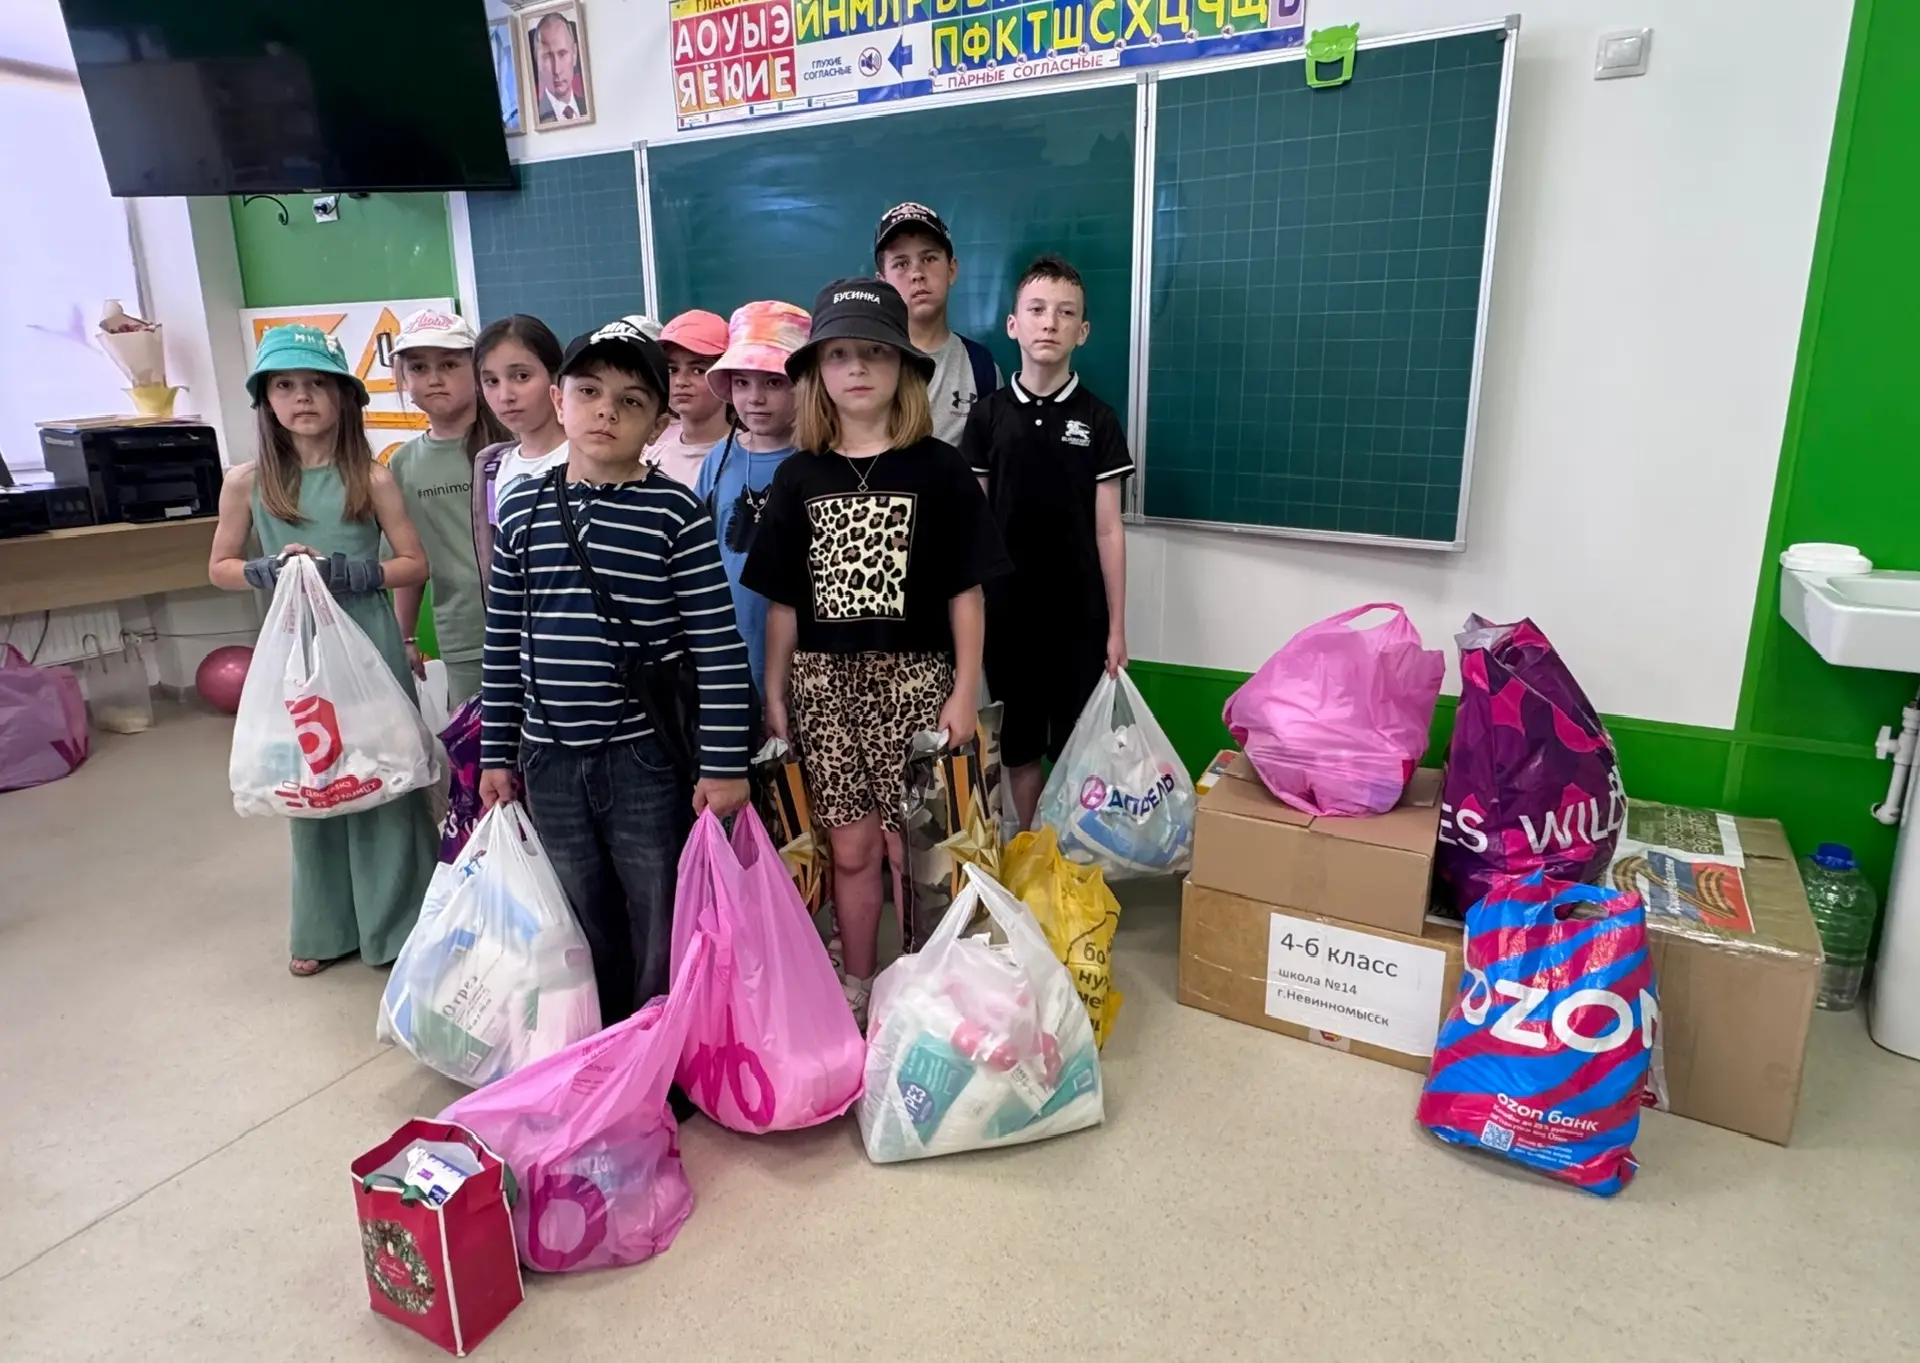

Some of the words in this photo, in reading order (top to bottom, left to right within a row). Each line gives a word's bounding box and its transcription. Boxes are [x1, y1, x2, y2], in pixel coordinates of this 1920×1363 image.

[803, 65, 852, 81] СОГЛАСНЫЕ
[812, 56, 842, 69] ГЛУХИЕ
[948, 70, 1005, 89] ПАРНЫЕ
[1013, 55, 1103, 79] СОГЛАСНЫЕ
[833, 290, 881, 305] БУСИНКА
[1107, 773, 1175, 817] АПРЕЛЬ
[1328, 947, 1398, 978] класс
[1278, 968, 1321, 986] школа
[1325, 978, 1357, 995] №14
[1277, 988, 1389, 1027] г.Невинномысск
[1497, 1093, 1544, 1121] ozon
[1548, 1111, 1599, 1131] банк
